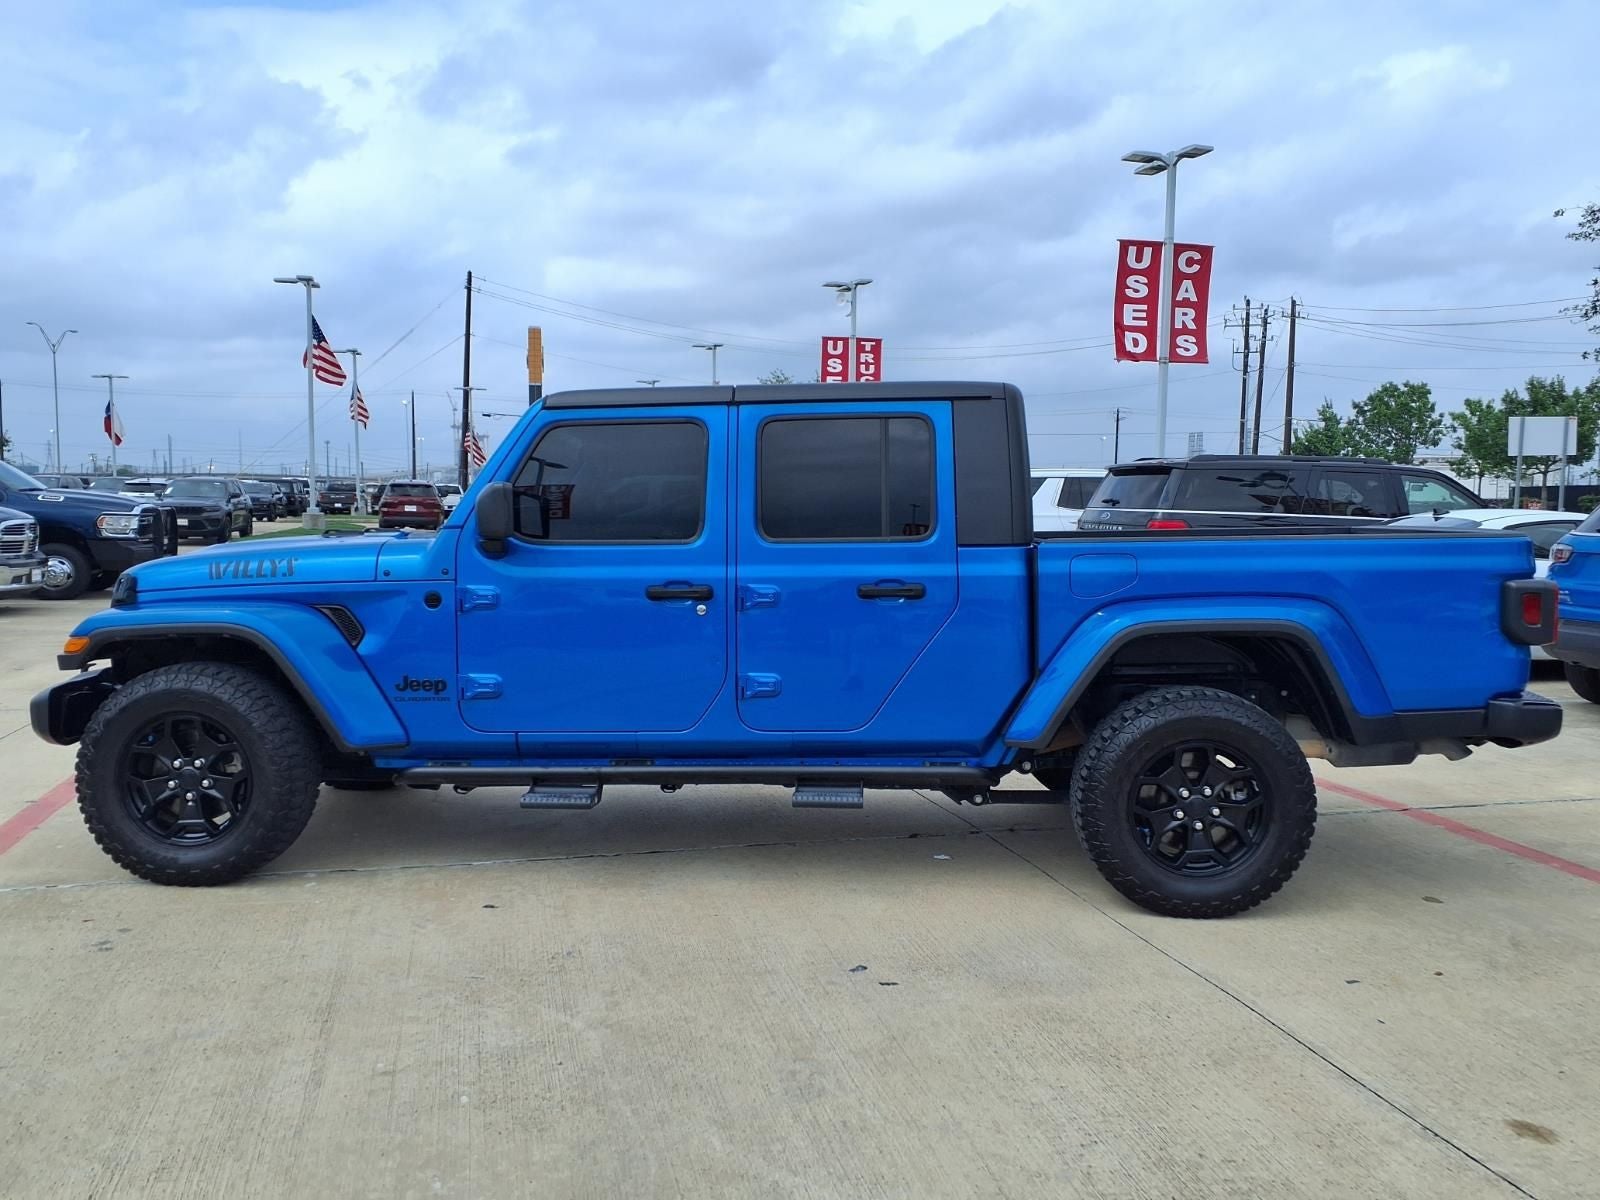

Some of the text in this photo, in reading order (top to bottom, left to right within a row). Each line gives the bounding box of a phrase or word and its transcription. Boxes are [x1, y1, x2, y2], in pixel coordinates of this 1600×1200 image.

[1123, 245, 1153, 354] USED
[1174, 250, 1202, 357] CARS
[209, 556, 298, 580] WILLYS
[394, 674, 448, 695] Jeep
